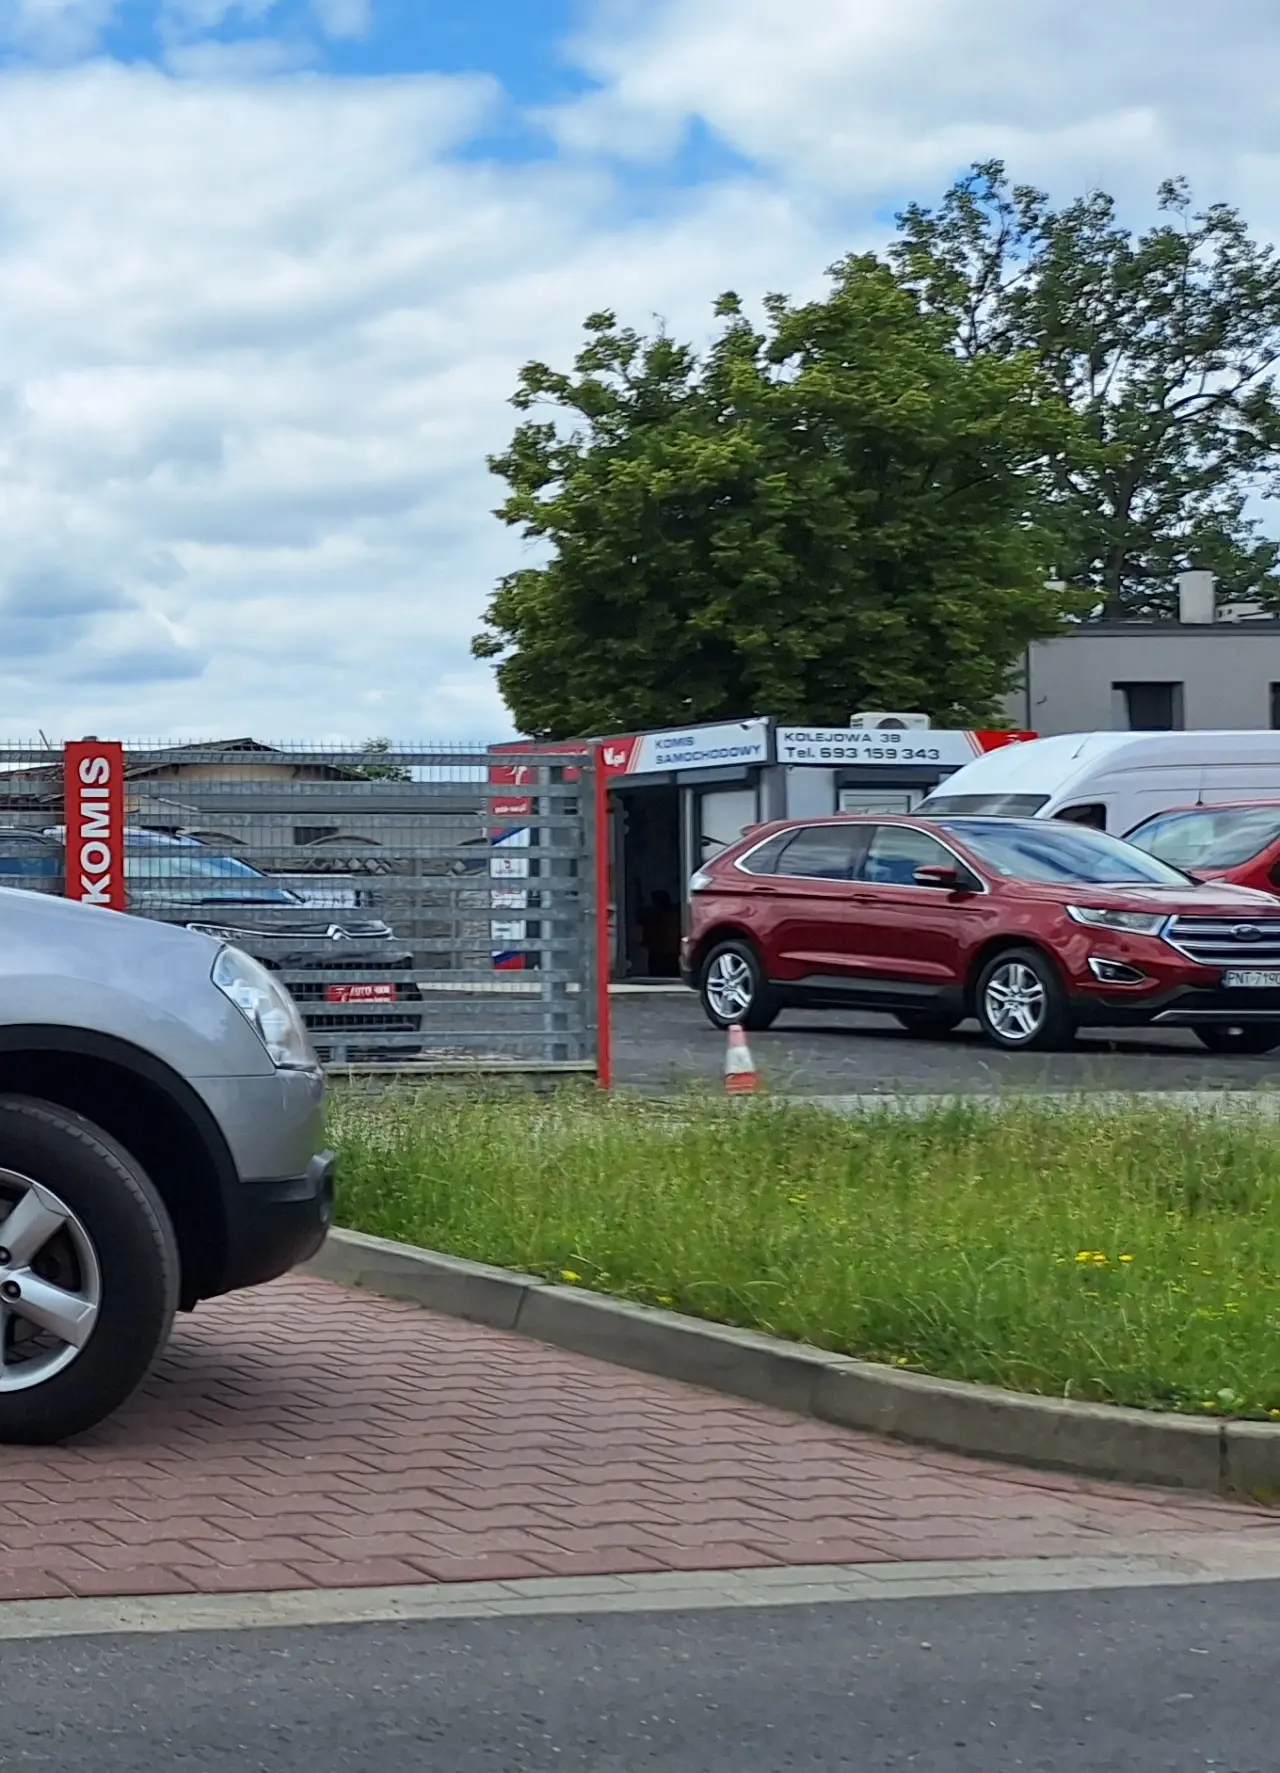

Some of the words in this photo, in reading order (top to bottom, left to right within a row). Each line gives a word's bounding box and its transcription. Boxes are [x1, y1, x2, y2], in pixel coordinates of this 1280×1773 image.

[655, 736, 694, 749] KOMIS
[784, 732, 872, 743] KOLEJOWA
[655, 744, 761, 765] SAMOCHODOWY
[784, 747, 815, 759] Tel.
[820, 747, 858, 759] 693
[863, 748, 897, 760] 159
[902, 748, 940, 760] 343
[79, 756, 111, 904] KOMIS
